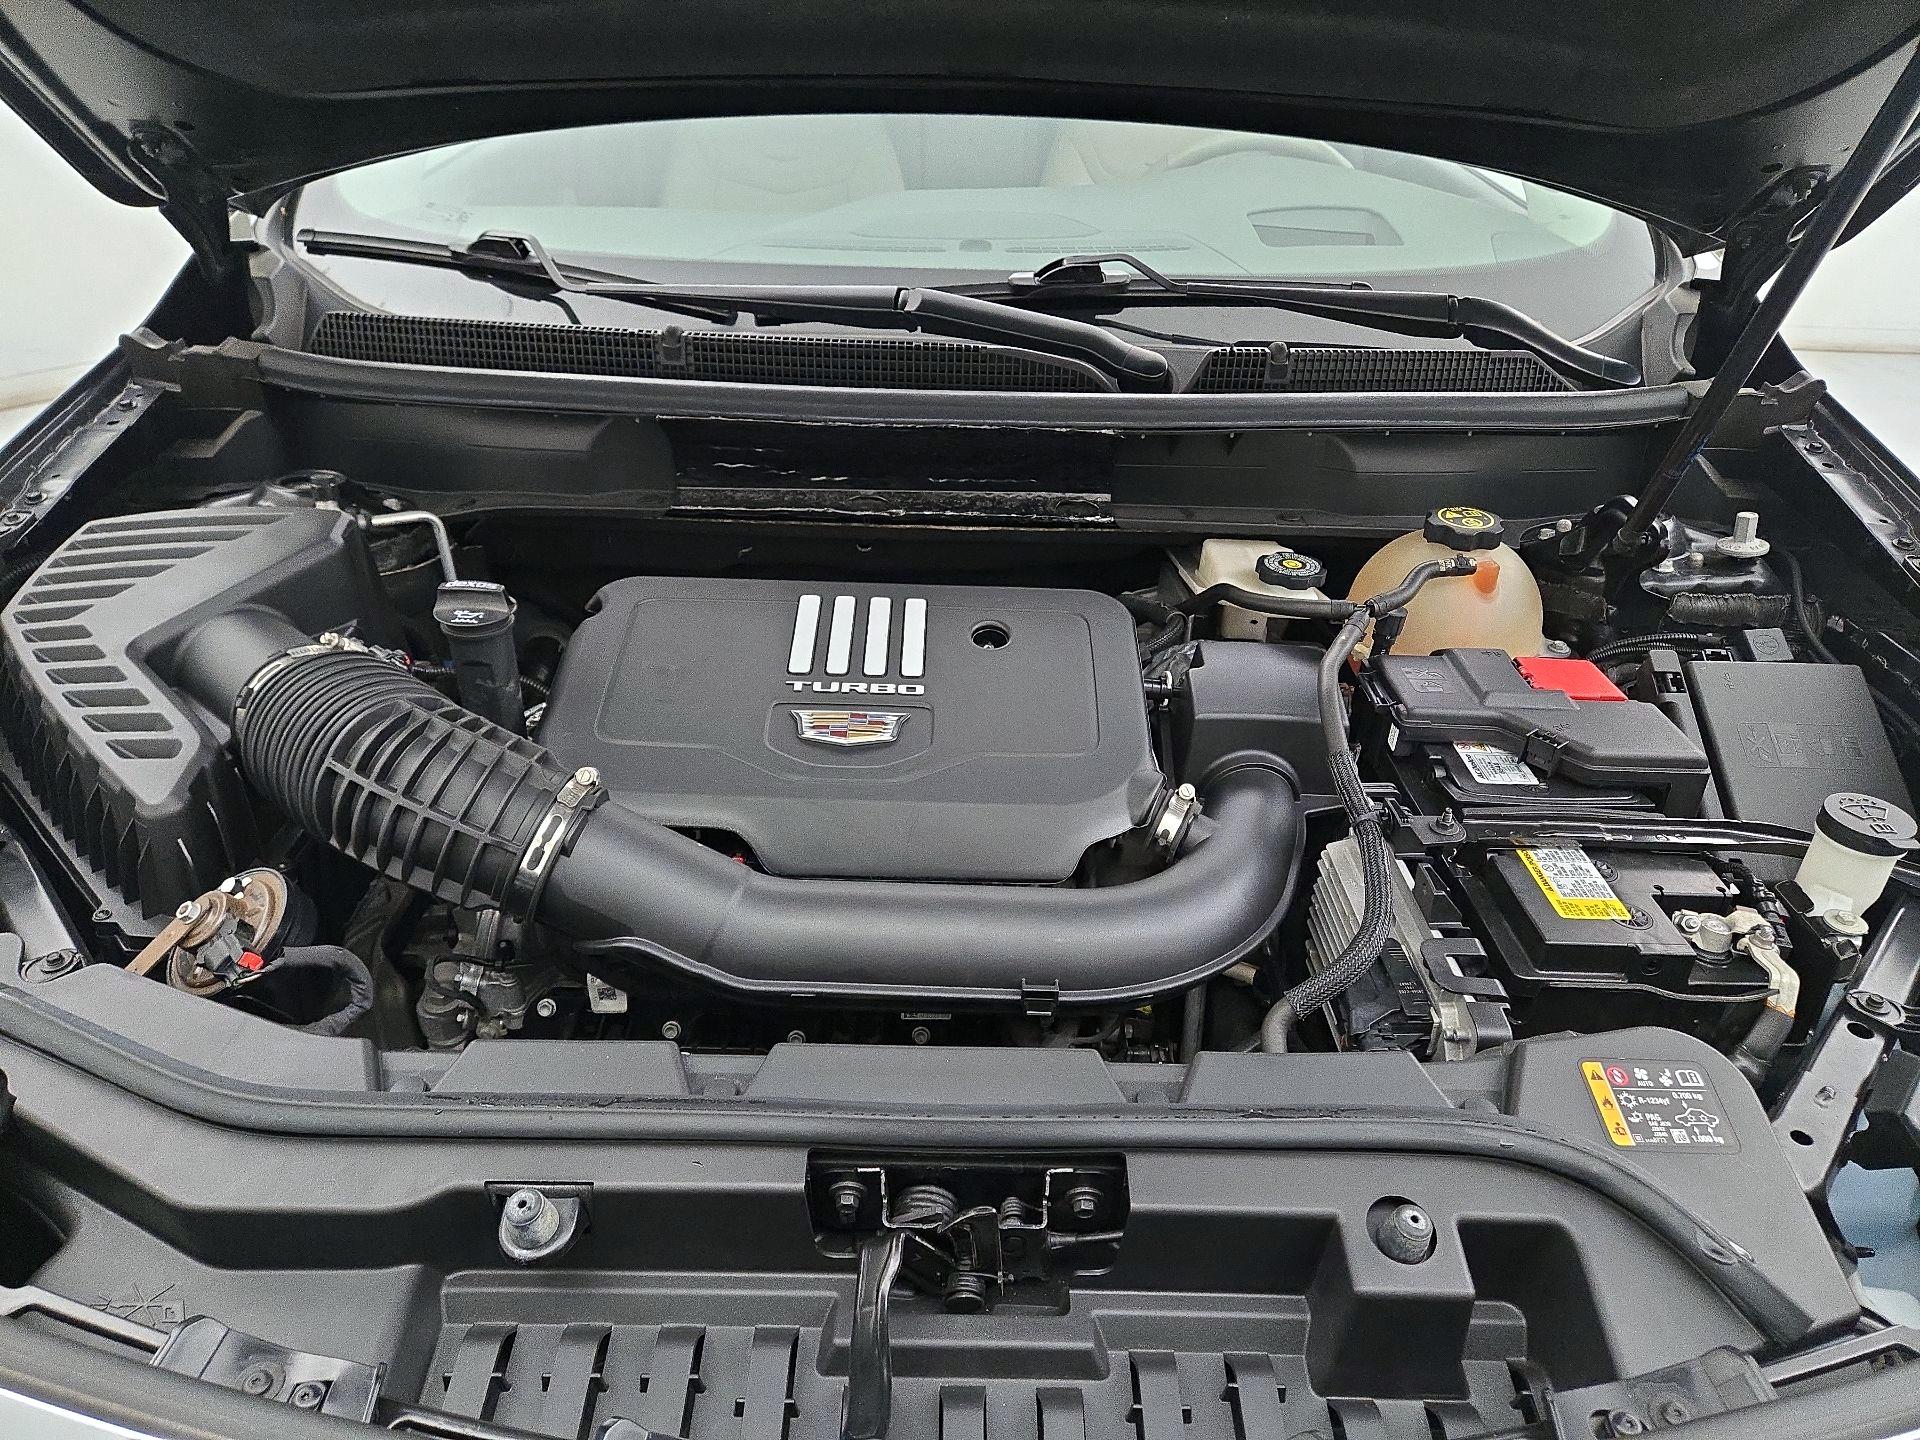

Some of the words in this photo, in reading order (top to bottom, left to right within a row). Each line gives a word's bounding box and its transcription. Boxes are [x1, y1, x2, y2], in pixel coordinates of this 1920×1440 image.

[445, 580, 498, 590] dexos
[785, 680, 925, 696] TURBO
[1637, 1096, 1670, 1106] R-1234yf
[1692, 1092, 1704, 1101] kg
[1644, 1113, 1662, 1121] PAG
